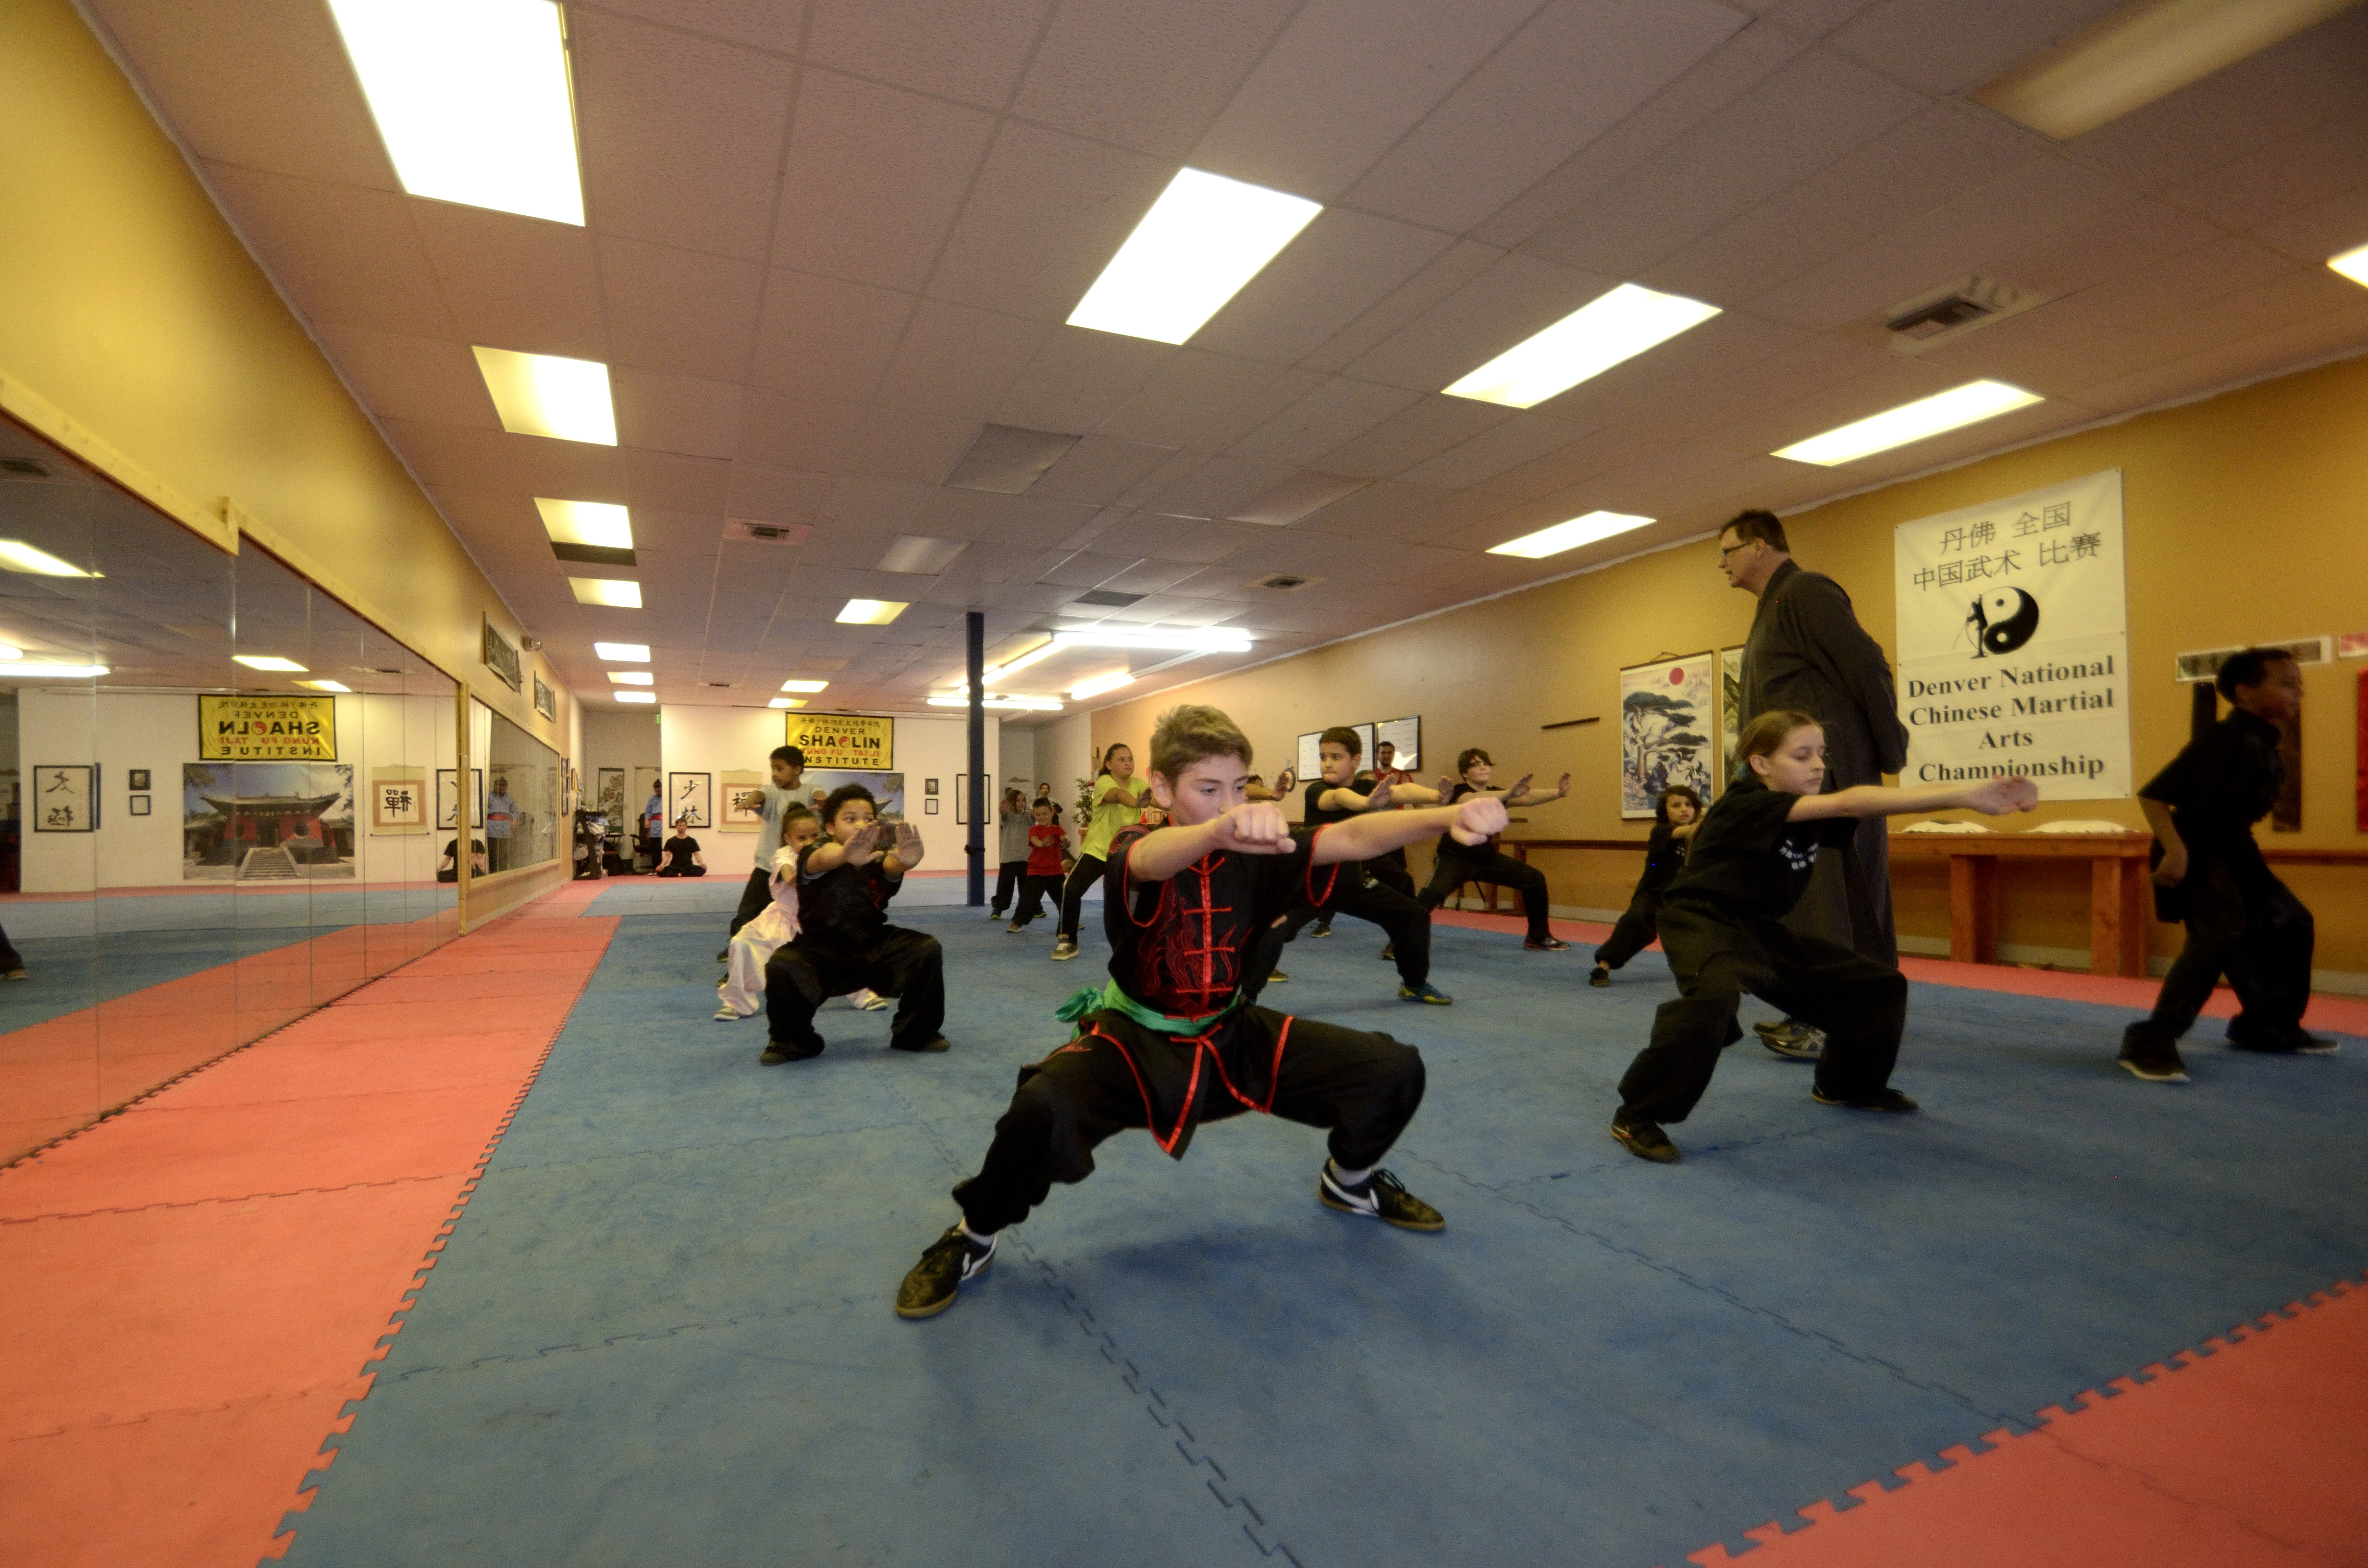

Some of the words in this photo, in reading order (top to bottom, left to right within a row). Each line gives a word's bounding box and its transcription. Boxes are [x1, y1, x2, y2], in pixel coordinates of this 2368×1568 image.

[1940, 521, 1996, 555] 丹佛
[2012, 501, 2071, 538] 全国
[1913, 550, 2022, 591] 中国武术
[2039, 532, 2101, 567] 比赛
[1907, 674, 1992, 698] Denver
[1999, 655, 2115, 687] National
[1909, 705, 2002, 726] Chinese
[2010, 688, 2115, 717] Martial
[815, 726, 865, 735] DENVER
[1979, 730, 2033, 749] Arts
[804, 757, 879, 766] NSTITUTE
[1919, 754, 2104, 782] Championship
